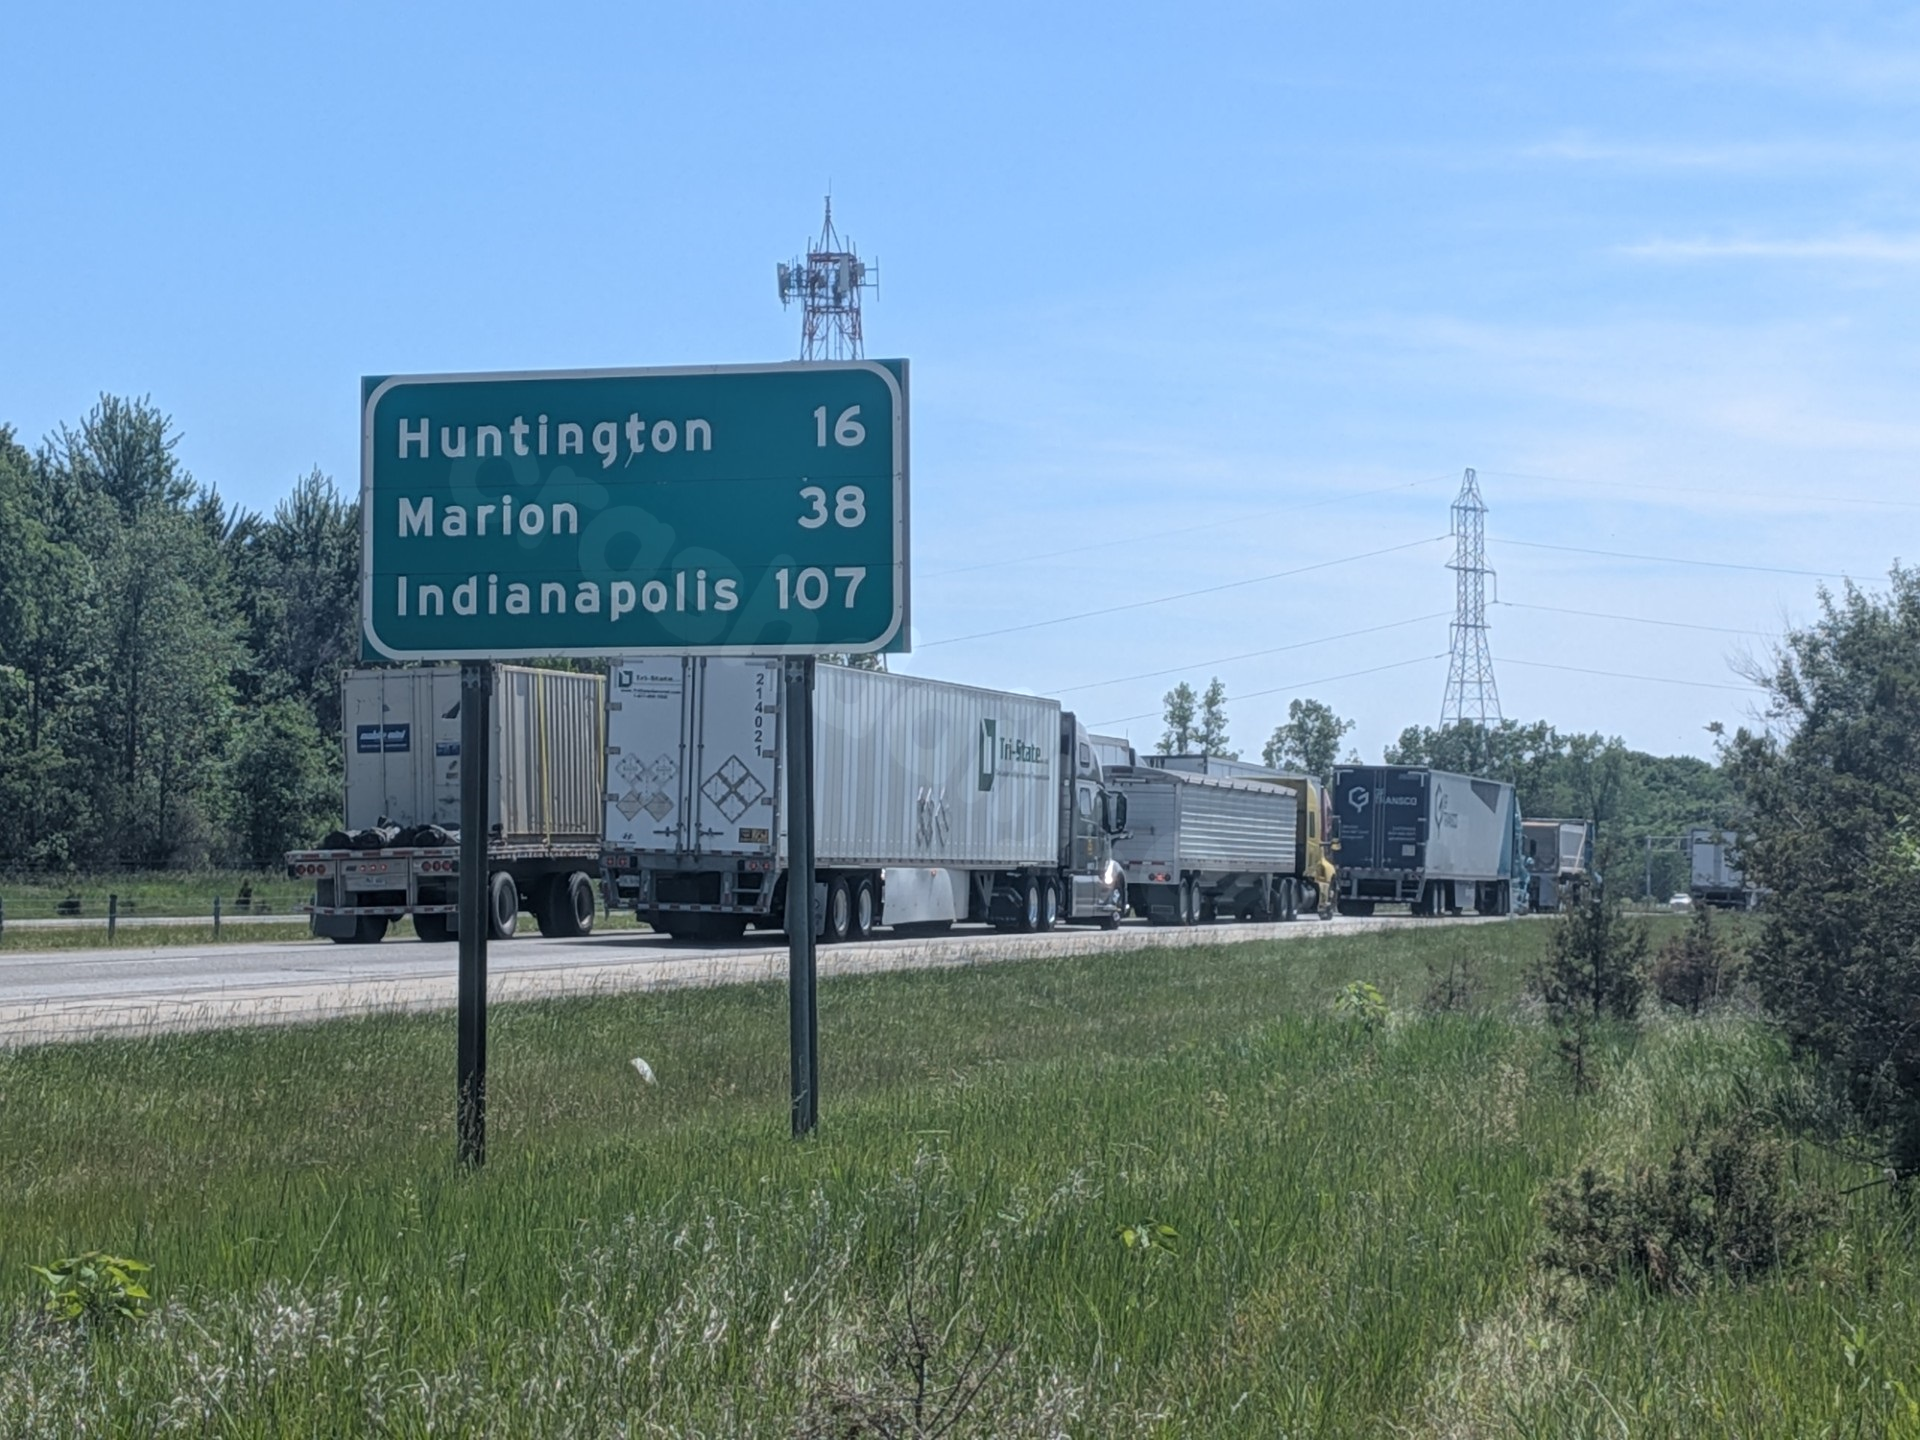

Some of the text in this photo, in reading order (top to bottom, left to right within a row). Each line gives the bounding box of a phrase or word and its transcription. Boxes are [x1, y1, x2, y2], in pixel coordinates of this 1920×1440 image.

[398, 404, 866, 469] Huntington 16
[398, 485, 867, 538] Marion 38
[397, 566, 867, 623] Indianapolis 107
[754, 673, 765, 757] 214021
[1000, 737, 1041, 763] Tri-State
